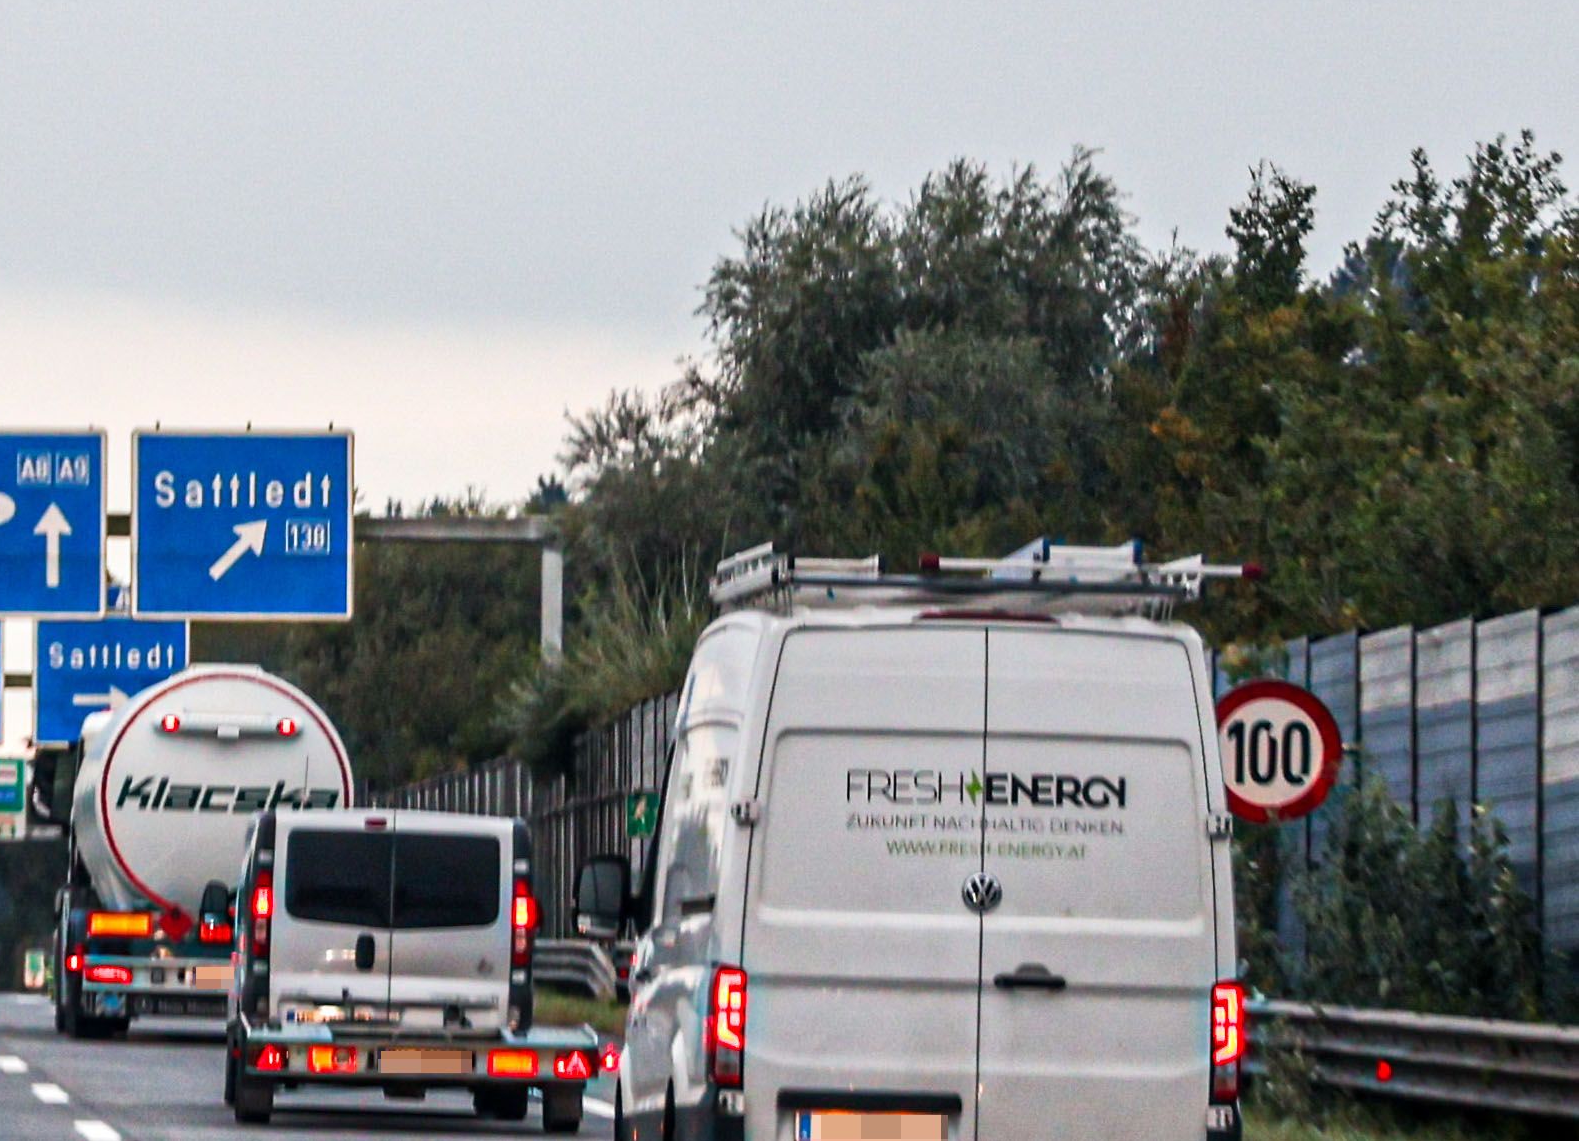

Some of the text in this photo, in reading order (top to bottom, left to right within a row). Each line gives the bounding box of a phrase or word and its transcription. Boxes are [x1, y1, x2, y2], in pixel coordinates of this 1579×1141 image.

[154, 470, 331, 508] Sattledt
[49, 642, 174, 669] Sattledt
[1227, 719, 1311, 785] 100
[115, 775, 340, 813] Klacska
[846, 769, 964, 804] FRESH
[846, 813, 926, 832] ZUKUNFT
[1049, 816, 1125, 836] DENKEN
